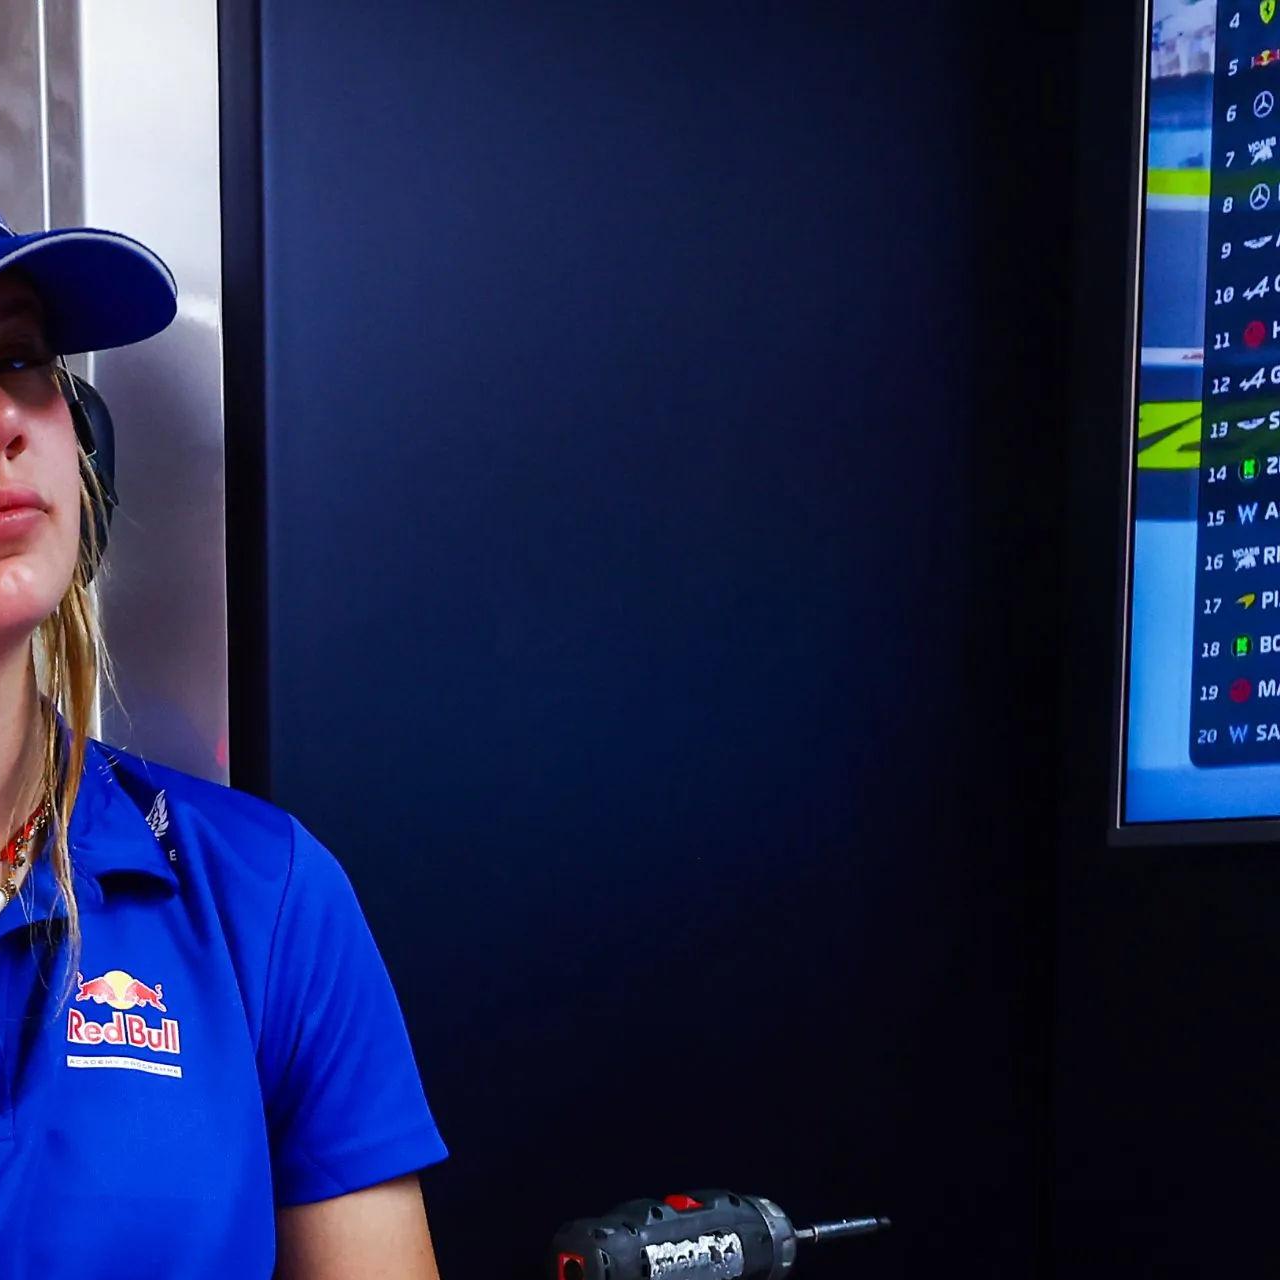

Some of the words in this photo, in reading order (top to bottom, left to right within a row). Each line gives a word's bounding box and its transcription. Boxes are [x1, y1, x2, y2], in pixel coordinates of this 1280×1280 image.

[1229, 12, 1240, 29] 4
[1228, 58, 1239, 76] 5
[1226, 104, 1237, 122] 6
[1225, 150, 1235, 168] 7
[1222, 197, 1233, 213] 8
[1221, 242, 1232, 259] 9
[1214, 286, 1235, 305] 10
[1213, 332, 1230, 350] 11
[1212, 376, 1230, 394] 12
[1210, 421, 1228, 438] 13
[1208, 465, 1227, 483] 14
[1206, 510, 1226, 527] 15
[1204, 554, 1224, 571] 16
[1203, 598, 1222, 614] 17
[1201, 641, 1220, 658] 18
[1200, 685, 1219, 701] 19
[1197, 729, 1217, 744] 20
[67, 1008, 126, 1045] Red
[125, 1013, 180, 1054] Bull
